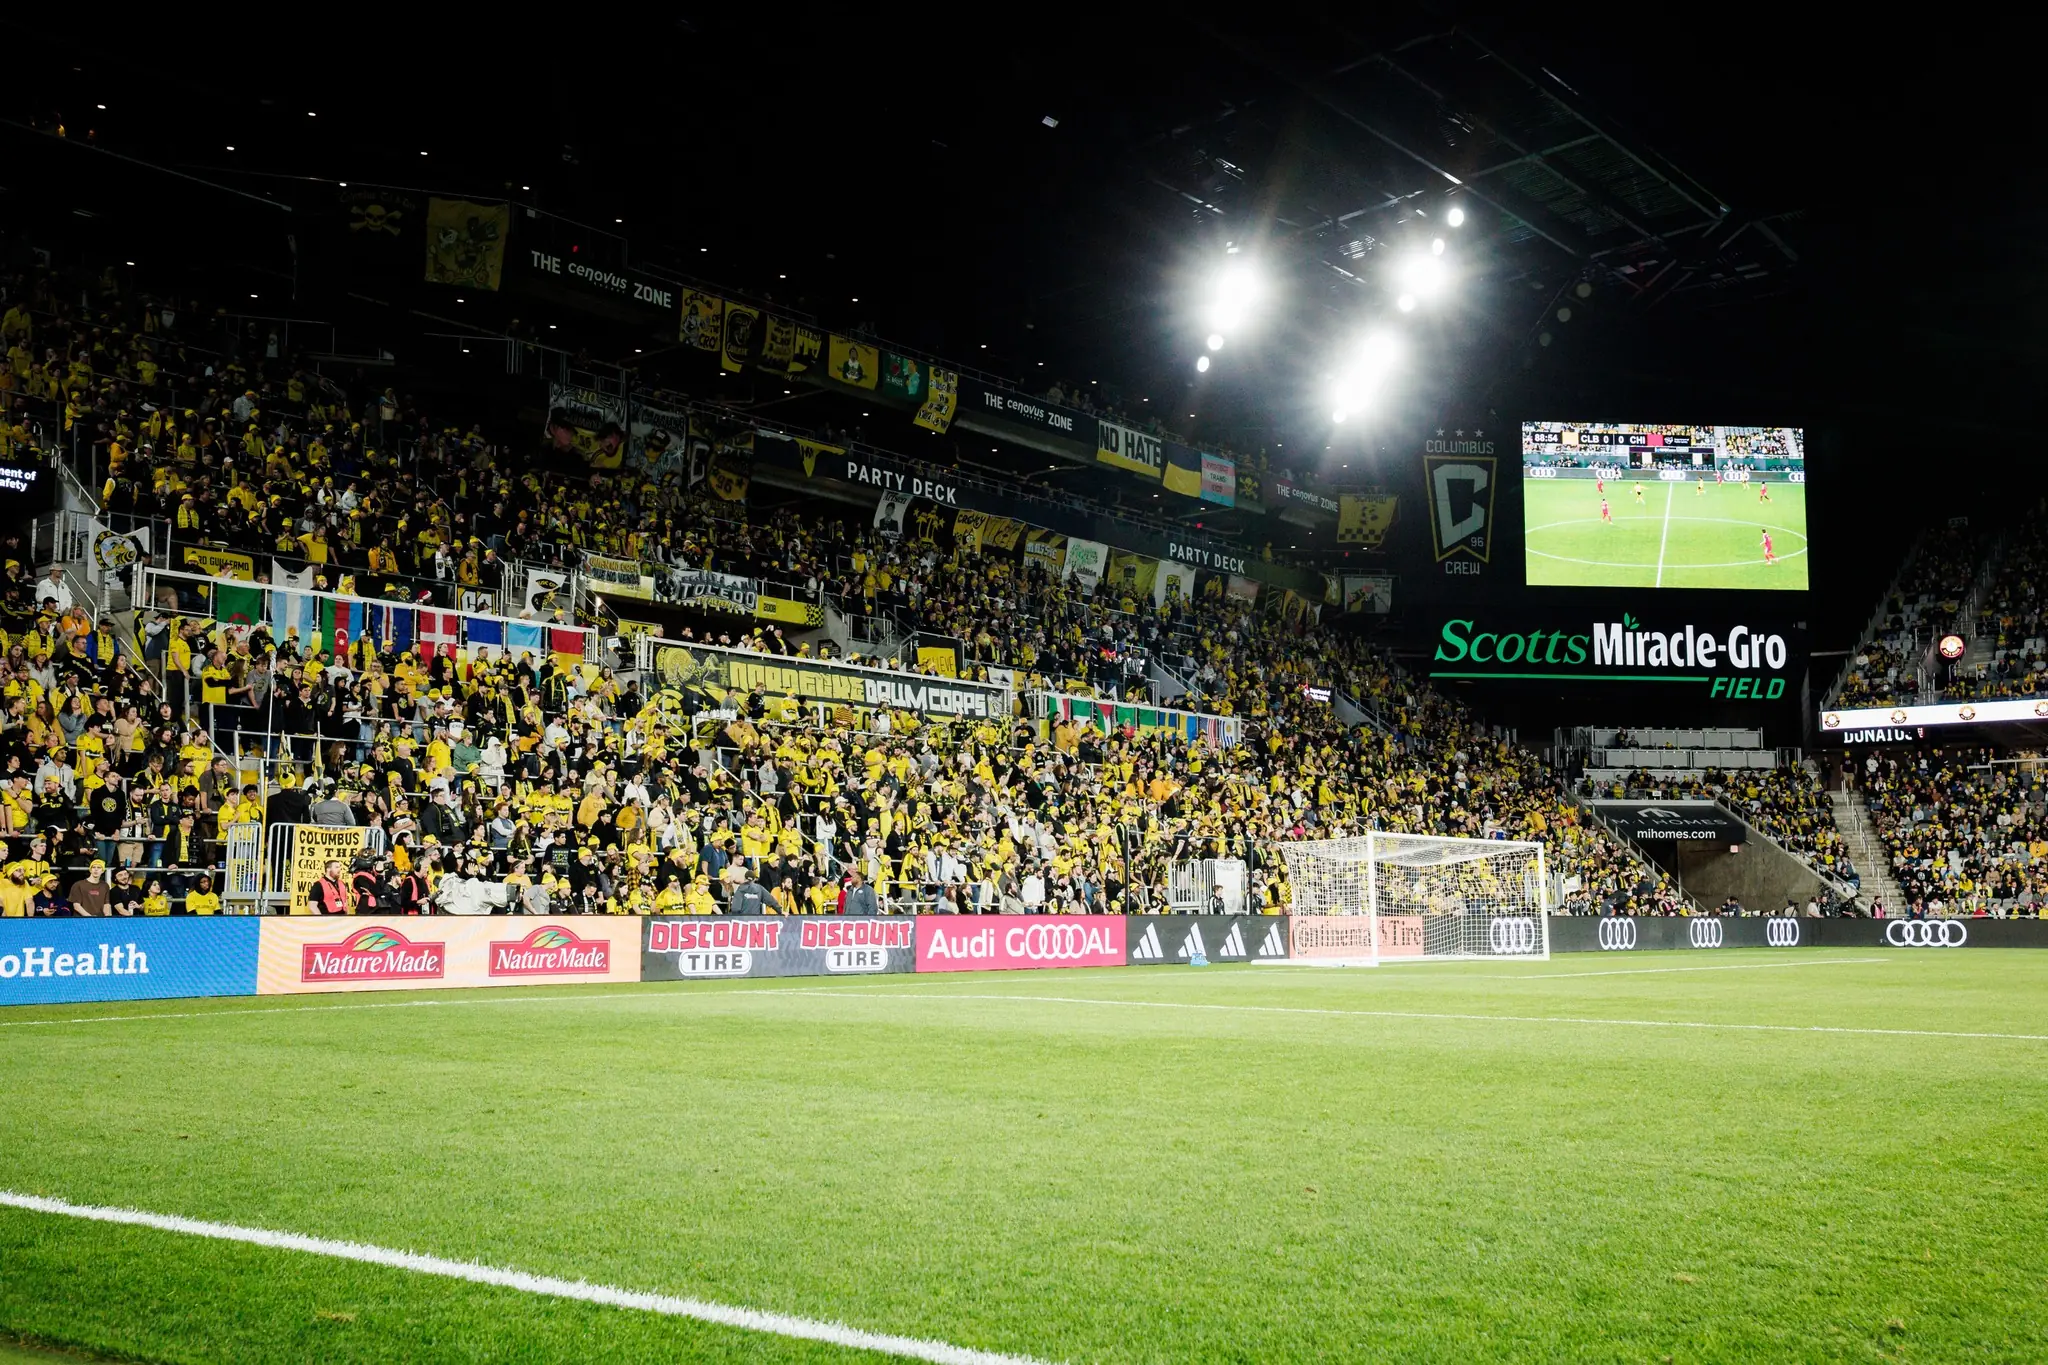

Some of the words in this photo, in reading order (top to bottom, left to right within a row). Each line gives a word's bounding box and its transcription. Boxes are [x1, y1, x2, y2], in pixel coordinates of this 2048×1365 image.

[531, 250, 561, 275] THE
[568, 261, 627, 289] cenovus
[634, 282, 672, 309] ZONE
[984, 391, 1004, 410] THE
[1048, 412, 1073, 431] ZONE
[1100, 424, 1119, 453] NO
[1125, 431, 1161, 465] HATE
[1426, 439, 1494, 454] COLUMBUS
[1534, 433, 1558, 442] 88:54
[1581, 435, 1599, 443] CLB
[1618, 436, 1624, 444] 0
[1629, 436, 1645, 444] CHI
[24, 471, 37, 480] of
[847, 461, 905, 491] PARTY
[913, 478, 957, 504] DECK
[1277, 484, 1290, 497] THE
[1320, 497, 1338, 512] ZONE
[1470, 536, 1484, 548] 96
[1169, 542, 1209, 565] PARTY
[1215, 555, 1245, 574] DECK
[1445, 561, 1480, 575] CREW
[680, 582, 756, 609] TOLEDO
[1434, 619, 1590, 664] Scotts
[1593, 622, 1787, 669] Miracle-Gro
[928, 687, 987, 716] CORPS
[1710, 677, 1786, 699] FIELD
[299, 830, 360, 845] COLUMBUS
[1637, 828, 1716, 840] mihomes.com
[300, 846, 315, 856] IS
[325, 848, 357, 858] THE
[650, 921, 780, 951] DISCOUNT
[801, 920, 911, 949] DISCOUNT
[927, 928, 995, 958] Audi
[687, 953, 743, 971] TIRE
[833, 951, 880, 966] TIRE
